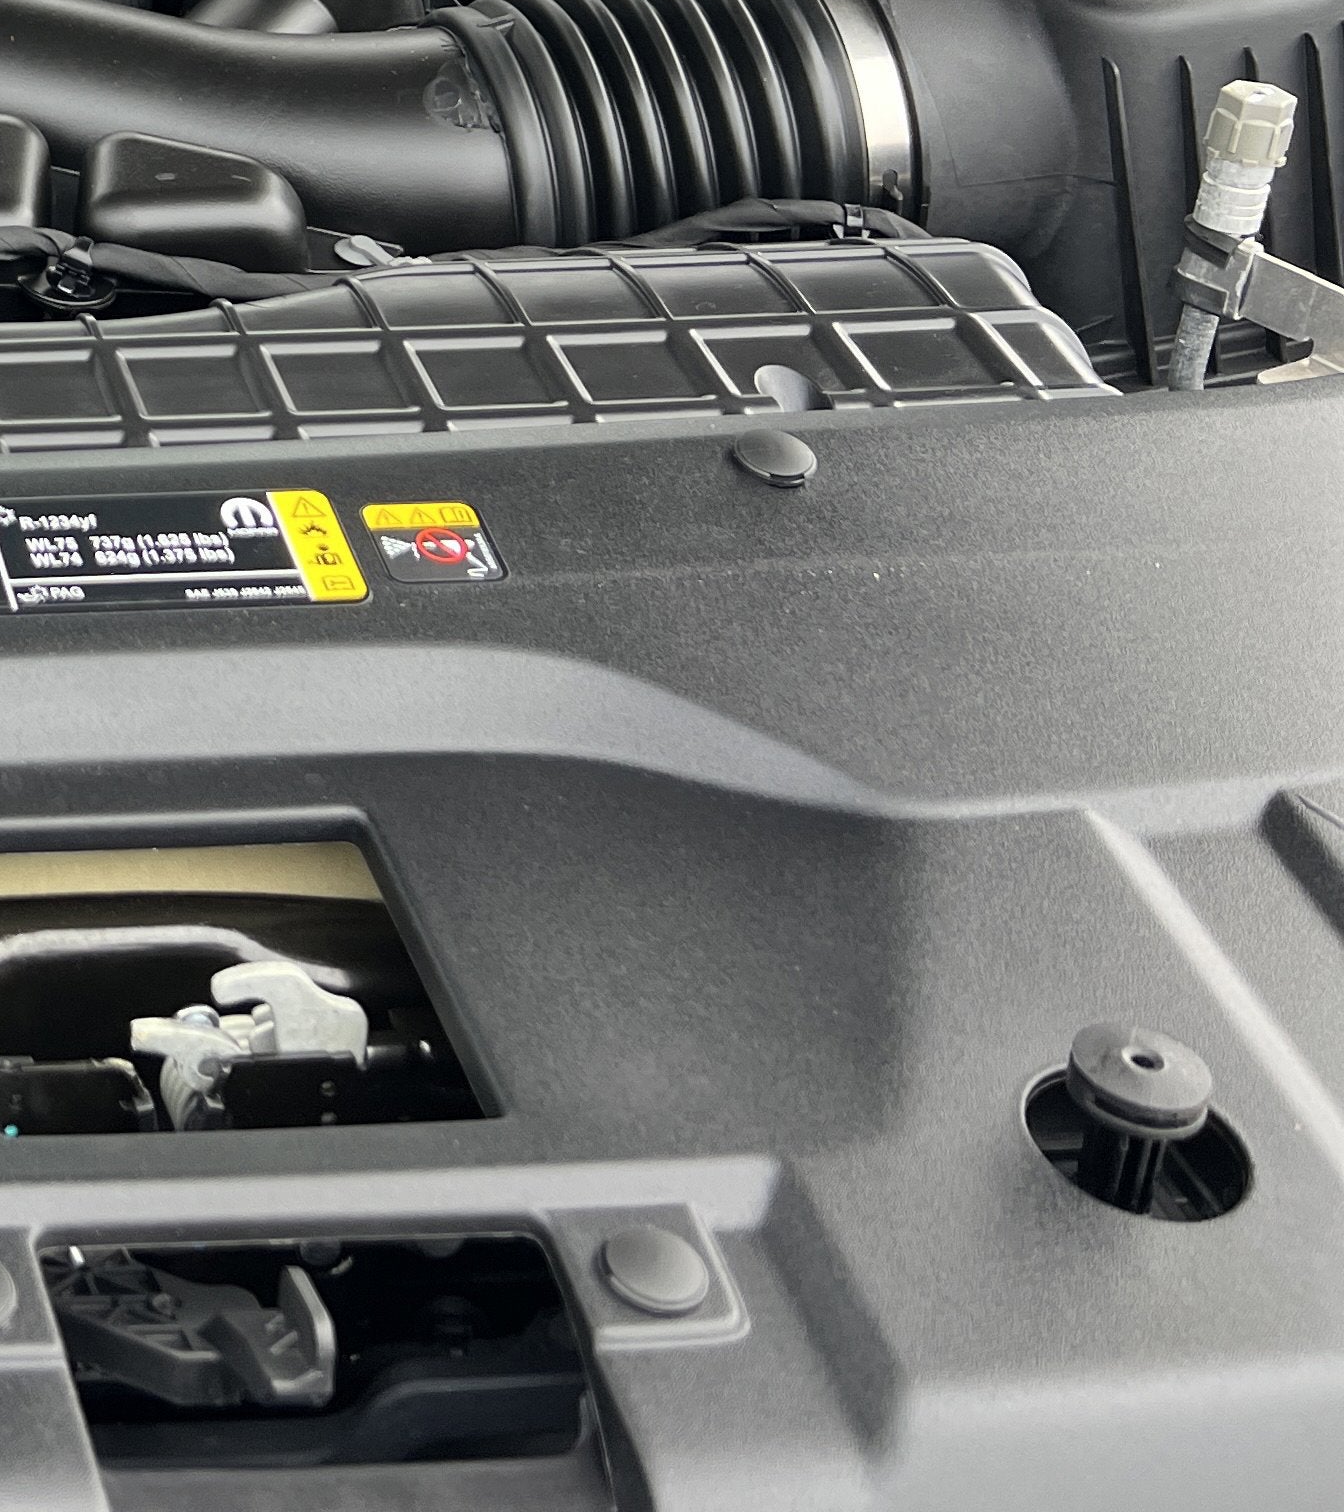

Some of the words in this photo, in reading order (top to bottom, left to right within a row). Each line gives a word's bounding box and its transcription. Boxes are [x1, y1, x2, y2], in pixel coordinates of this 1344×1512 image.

[18, 513, 98, 532] R-1234yf
[25, 536, 79, 553] WL75
[89, 534, 136, 552] 737g
[30, 551, 84, 569] WL74
[50, 586, 86, 601] PAG
